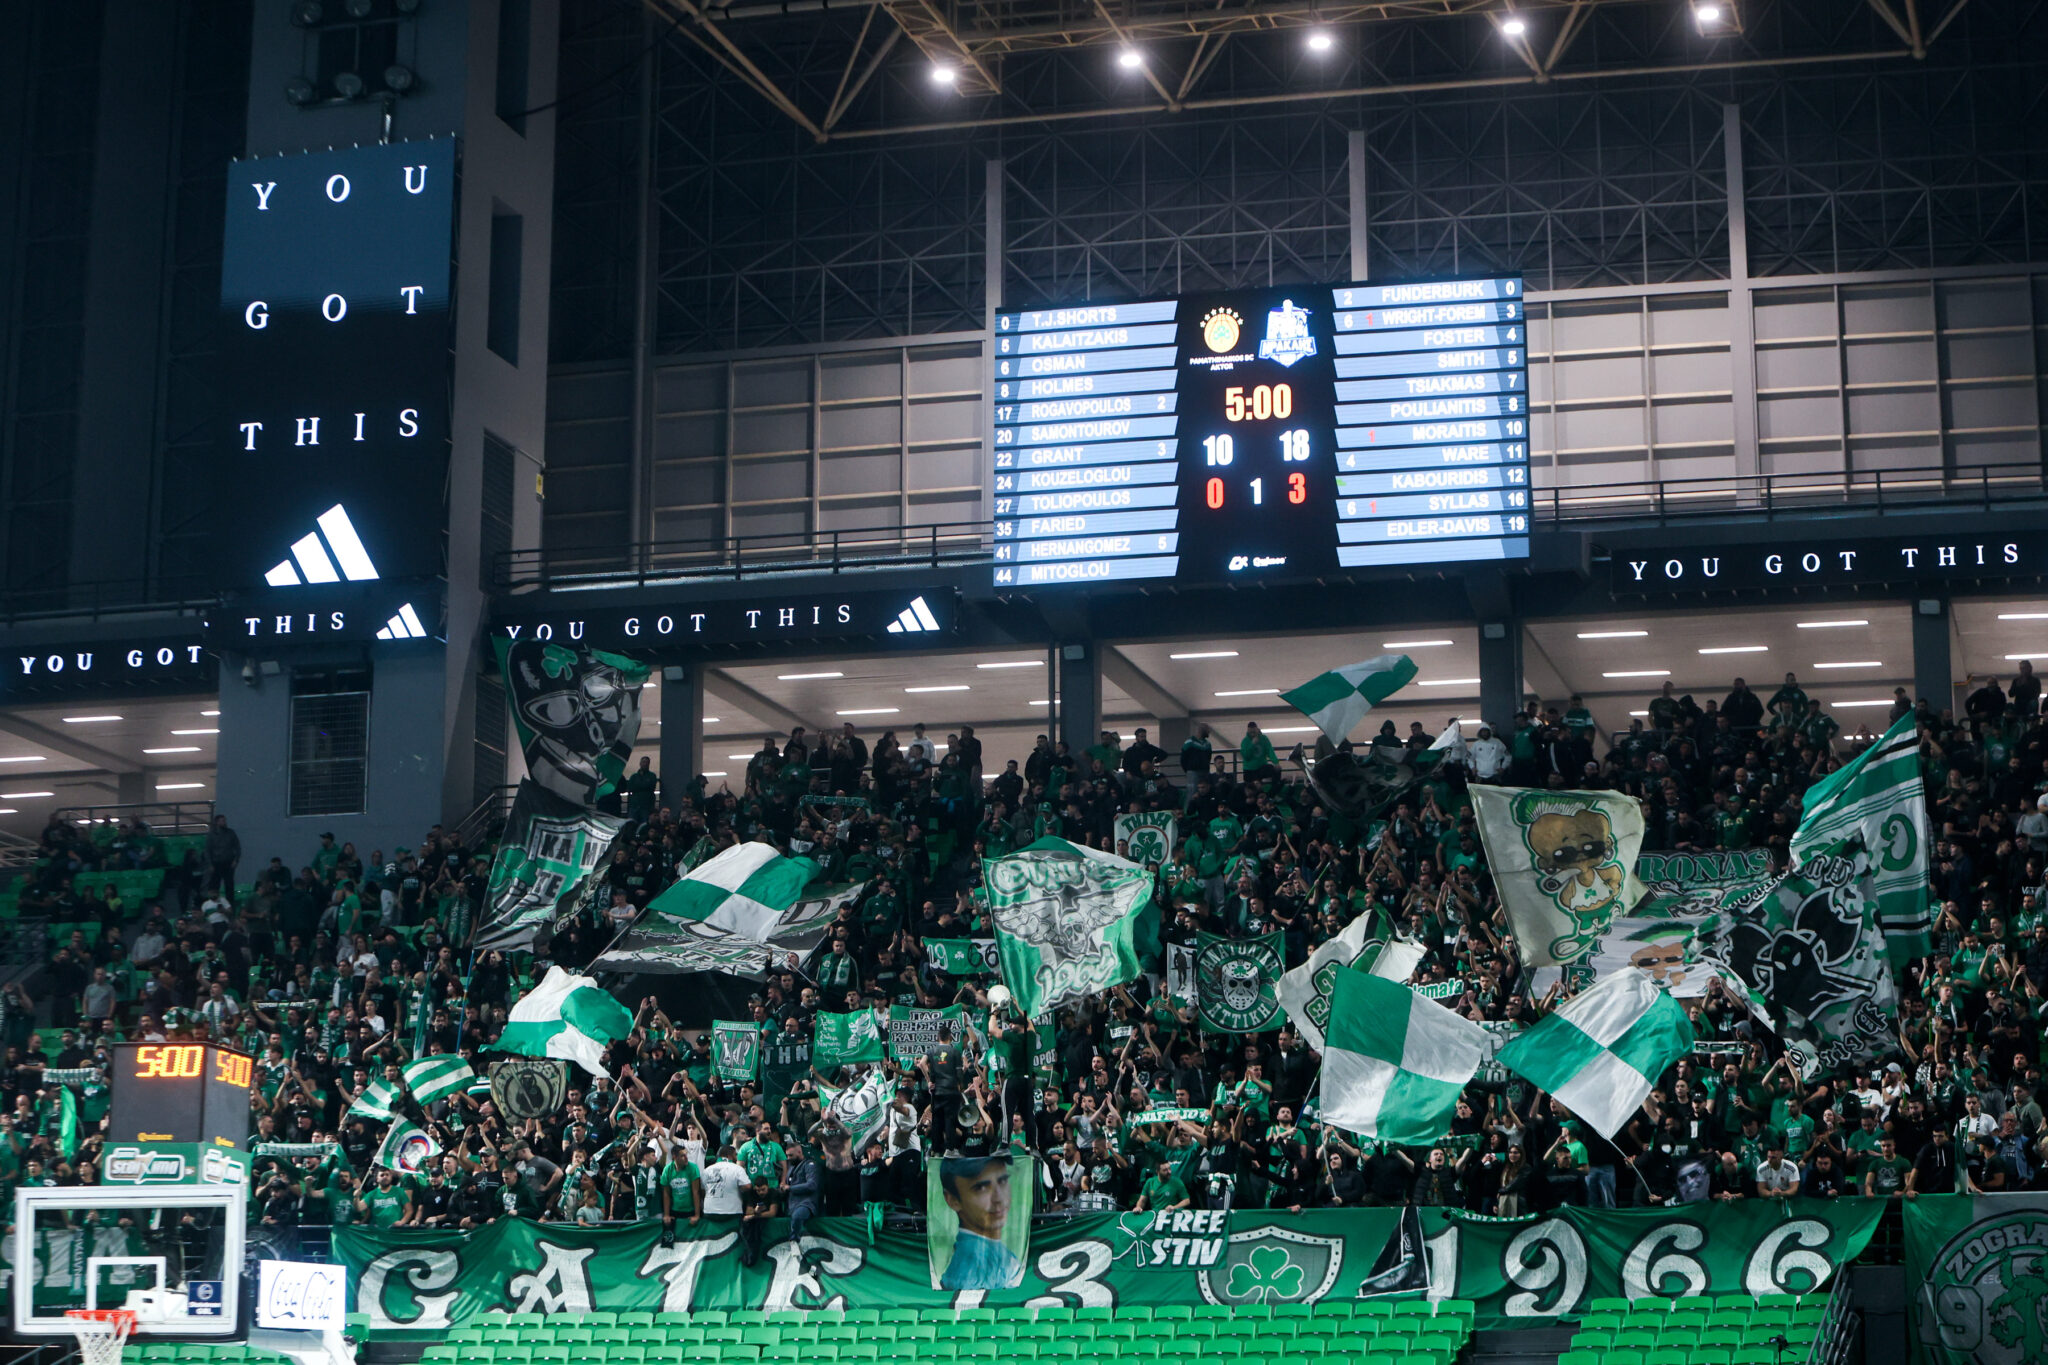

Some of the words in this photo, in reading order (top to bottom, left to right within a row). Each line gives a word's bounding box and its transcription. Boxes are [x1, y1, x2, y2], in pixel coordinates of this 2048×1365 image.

[252, 165, 428, 211] YOU
[1343, 291, 1353, 305] 2
[1381, 282, 1485, 302] FUNDERBURK
[1505, 281, 1516, 296] 0
[245, 286, 424, 330] GOT
[1001, 316, 1010, 330] 0
[1032, 307, 1117, 327] T.J.SHORTS
[1344, 314, 1353, 328] 6
[1365, 313, 1373, 327] 1
[1382, 305, 1486, 325] WRIGHT-FOREM
[1506, 304, 1516, 318] 3
[1001, 339, 1010, 352] 5
[1031, 329, 1129, 350] KALAITZAKIS
[1423, 329, 1485, 345] FOSTER
[1506, 327, 1517, 341] 4
[1000, 361, 1010, 375] 6
[1031, 355, 1086, 372] OSMAN
[1437, 352, 1485, 368] SMITH
[1507, 351, 1517, 365] 5
[1000, 384, 1010, 398] 8
[1031, 377, 1094, 395] HOLMES
[1406, 375, 1486, 393] TSIAKMAS
[1508, 374, 1518, 388] 7
[997, 407, 1013, 421] 17
[1031, 397, 1132, 418] ROGAVOPOULOS
[1157, 396, 1167, 410] 2
[1225, 383, 1292, 422] 5:00
[1390, 400, 1487, 418] POULIANITIS
[1508, 397, 1518, 412] 8
[239, 408, 419, 450] THIS
[997, 430, 1013, 444] 20
[1031, 421, 1131, 441] SAMONTOUROV
[1368, 429, 1376, 443] 1
[1412, 423, 1487, 440] MORAITIS
[1506, 421, 1523, 435] 10
[996, 453, 1013, 467] 22
[1031, 447, 1084, 464] GRANT
[1157, 443, 1167, 457] 3
[1203, 433, 1234, 466] 10
[1279, 429, 1311, 461] 18
[1346, 454, 1356, 468] 4
[1442, 446, 1489, 462] WARE
[1507, 444, 1523, 459] 11
[996, 476, 1013, 490] 24
[1031, 467, 1131, 487] KOUZELOGLOU
[1392, 469, 1489, 488] KABOURIDIS
[1507, 468, 1524, 483] 12
[996, 499, 1012, 513] 27
[1031, 491, 1131, 510] TOLIOPOULOS
[1207, 477, 1224, 509] 0
[1250, 478, 1262, 505] 1
[1288, 472, 1306, 504] 3
[1347, 502, 1357, 516] 6
[1369, 500, 1377, 514] 1
[1428, 493, 1490, 511] SYLLAS
[1508, 492, 1525, 506] 16
[996, 522, 1012, 536] 35
[1031, 517, 1086, 533] FARIED
[1387, 517, 1491, 536] EDLER-DAVIS
[1508, 516, 1525, 531] 19
[996, 546, 1011, 559] 41
[1031, 538, 1131, 557] HERNANGOMEZ
[1158, 536, 1167, 550] 5
[996, 569, 1012, 583] 44
[1031, 562, 1110, 580] MITOGLOU
[1630, 557, 1721, 581] YOU
[1765, 551, 1857, 575] GOT
[1901, 543, 2019, 568] THIS
[244, 611, 345, 637] THIS
[506, 622, 585, 641] YOU
[624, 613, 706, 637] GOT
[746, 604, 851, 629] THIS
[20, 653, 93, 675] YOU
[127, 645, 203, 669] GOT
[136, 1045, 205, 1077] 5:00
[215, 1050, 253, 1088] 5:00
[1154, 1209, 1227, 1233] FREE
[1149, 1237, 1224, 1266] STIV
